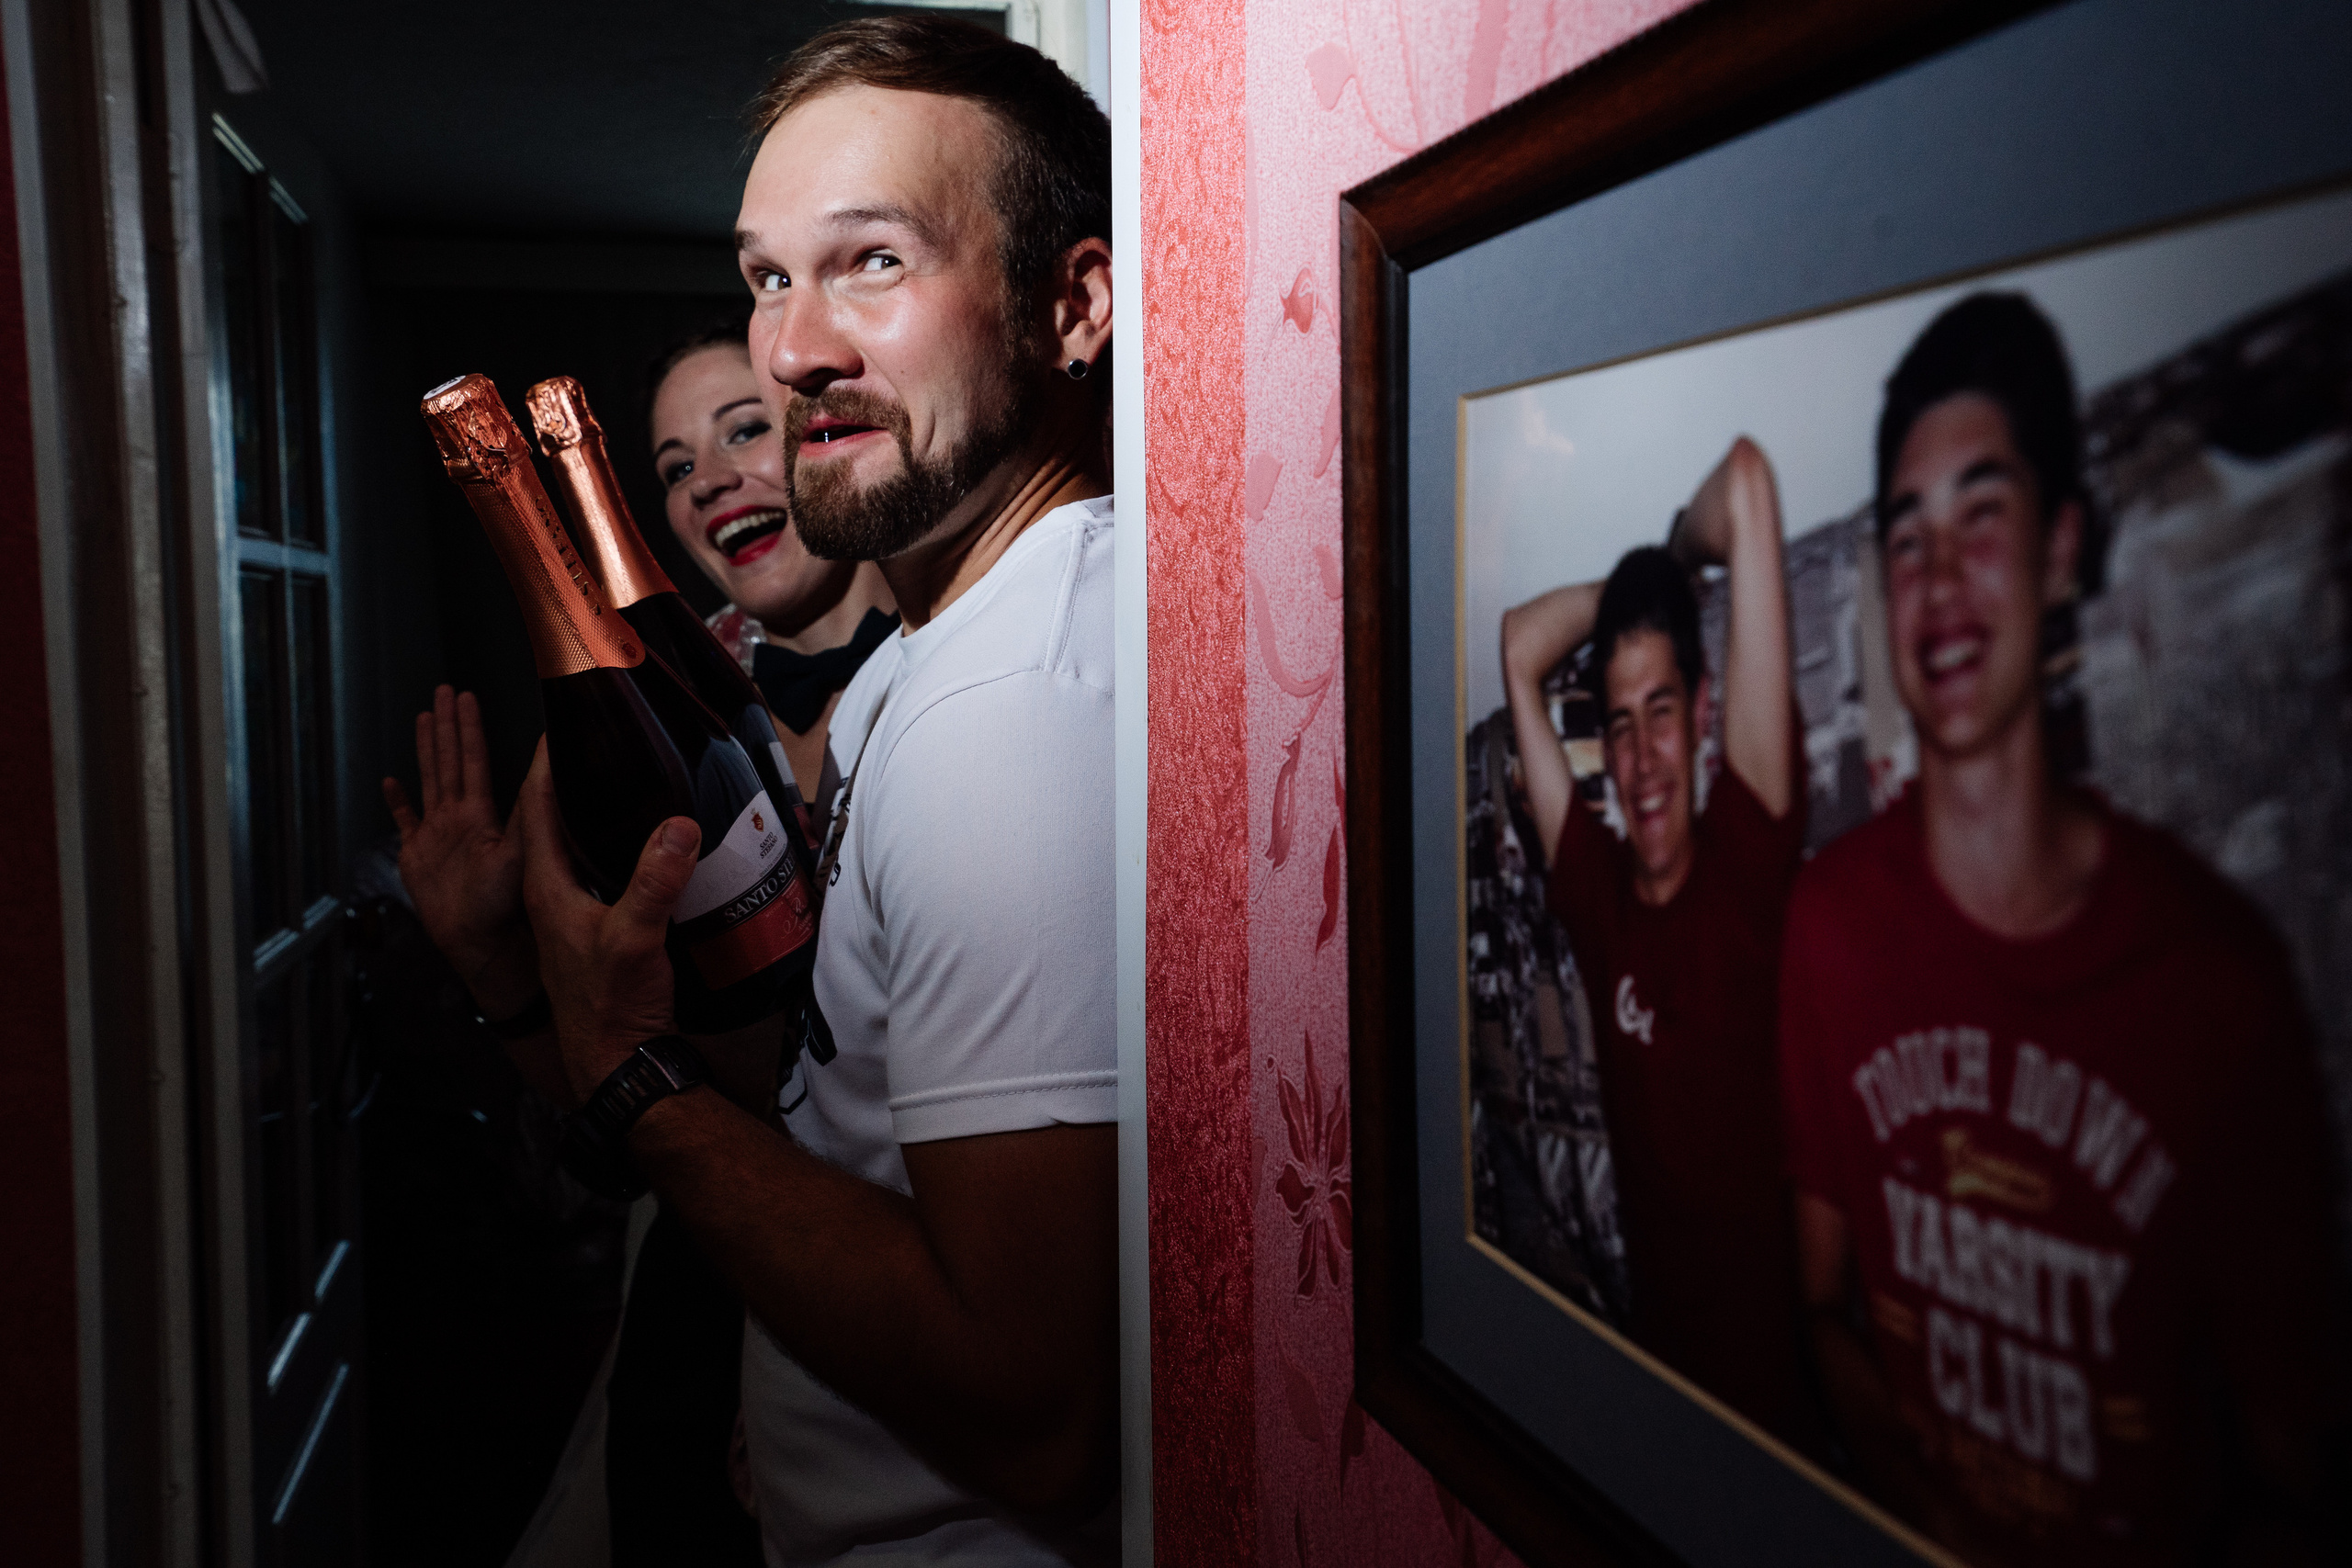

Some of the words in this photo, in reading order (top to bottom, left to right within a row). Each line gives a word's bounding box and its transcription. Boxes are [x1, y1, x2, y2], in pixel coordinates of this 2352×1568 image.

[759, 831, 774, 850] SANTO
[760, 835, 778, 860] STEFANO
[724, 877, 778, 923] SANTO
[1852, 1024, 1992, 1144] TOUCH
[2007, 1041, 2177, 1235] DOWN
[1883, 1175, 2132, 1361] VARSITY
[1929, 1305, 2098, 1483] CLUB
